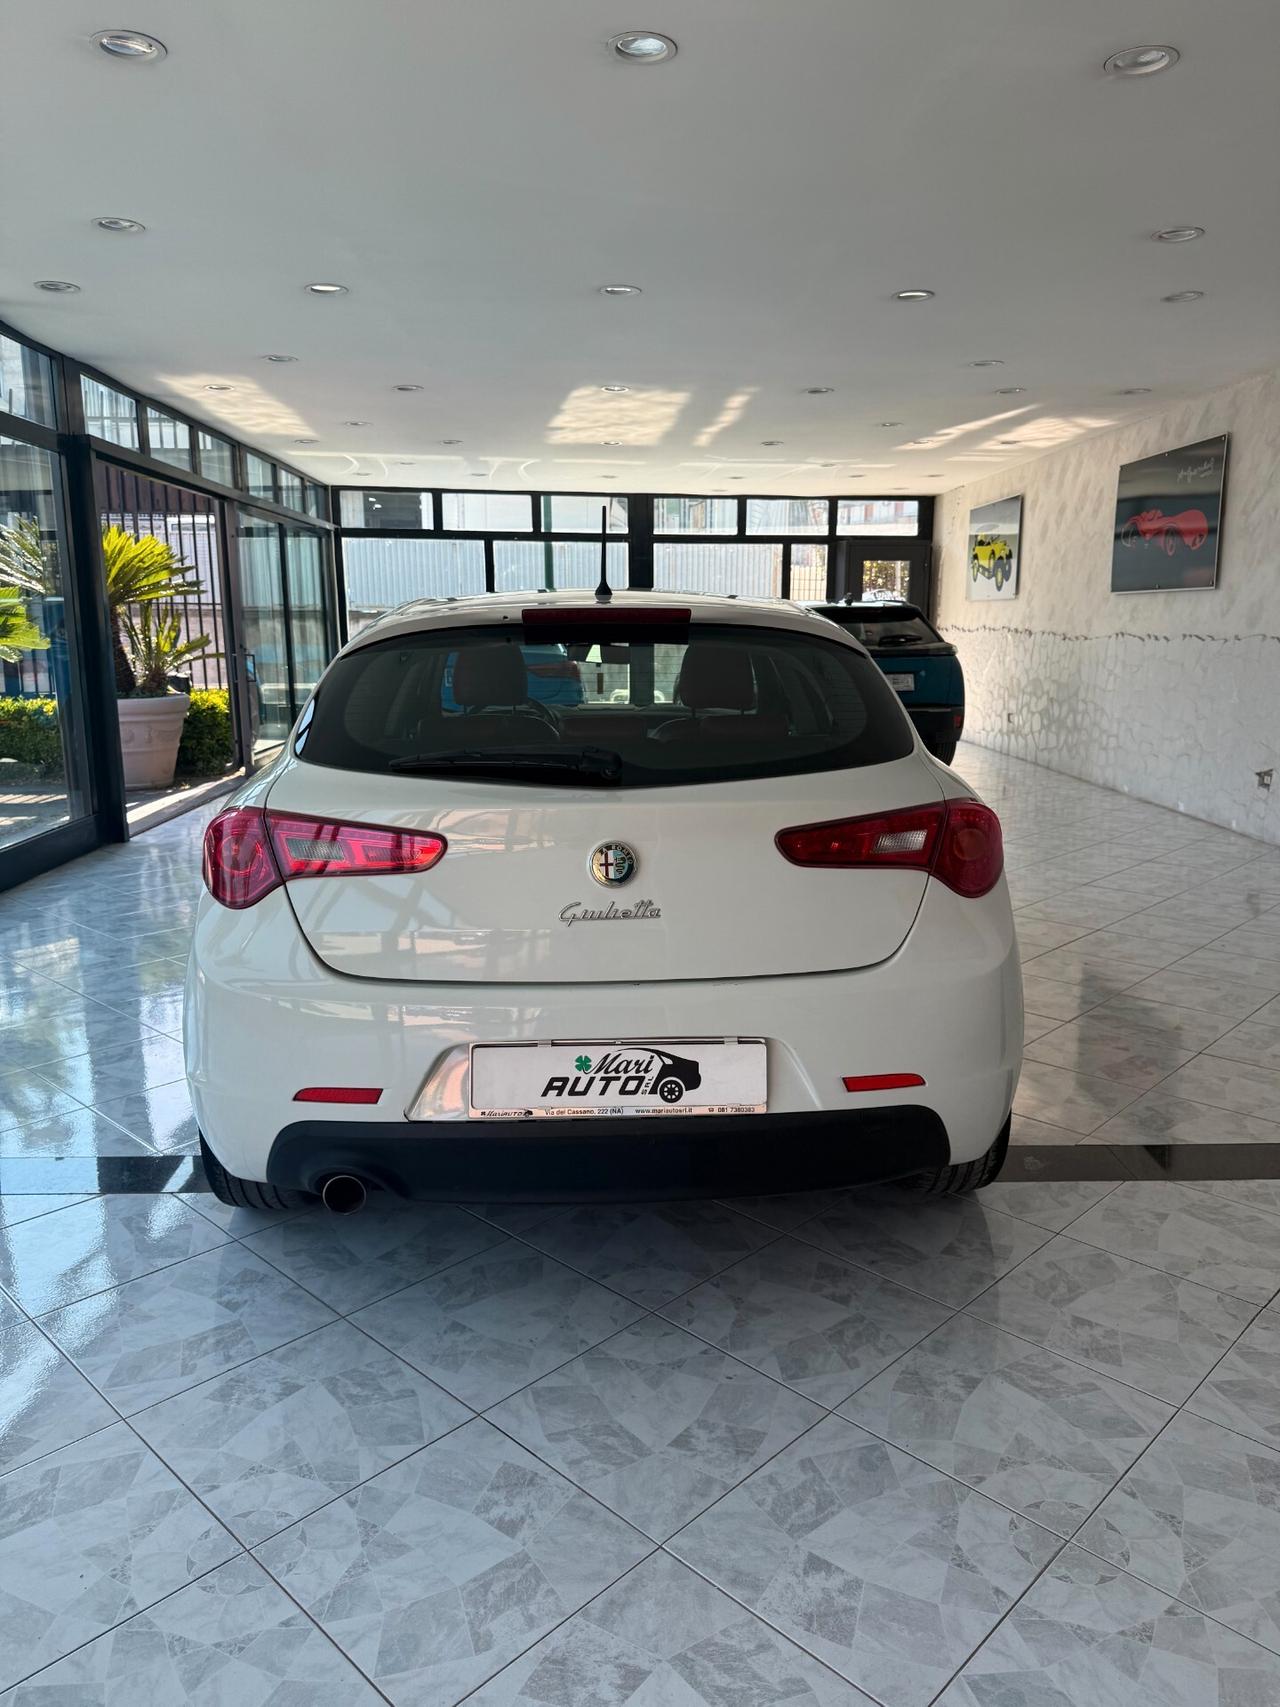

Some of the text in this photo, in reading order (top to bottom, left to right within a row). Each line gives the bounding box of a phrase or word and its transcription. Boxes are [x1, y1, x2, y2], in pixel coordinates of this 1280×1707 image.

[558, 899, 661, 927] Giulietta
[584, 1052, 655, 1075] Mari
[541, 1075, 646, 1097] AUTO
[545, 1107, 555, 1116] Via
[597, 1107, 609, 1115] 222
[610, 1107, 624, 1116] (NA)
